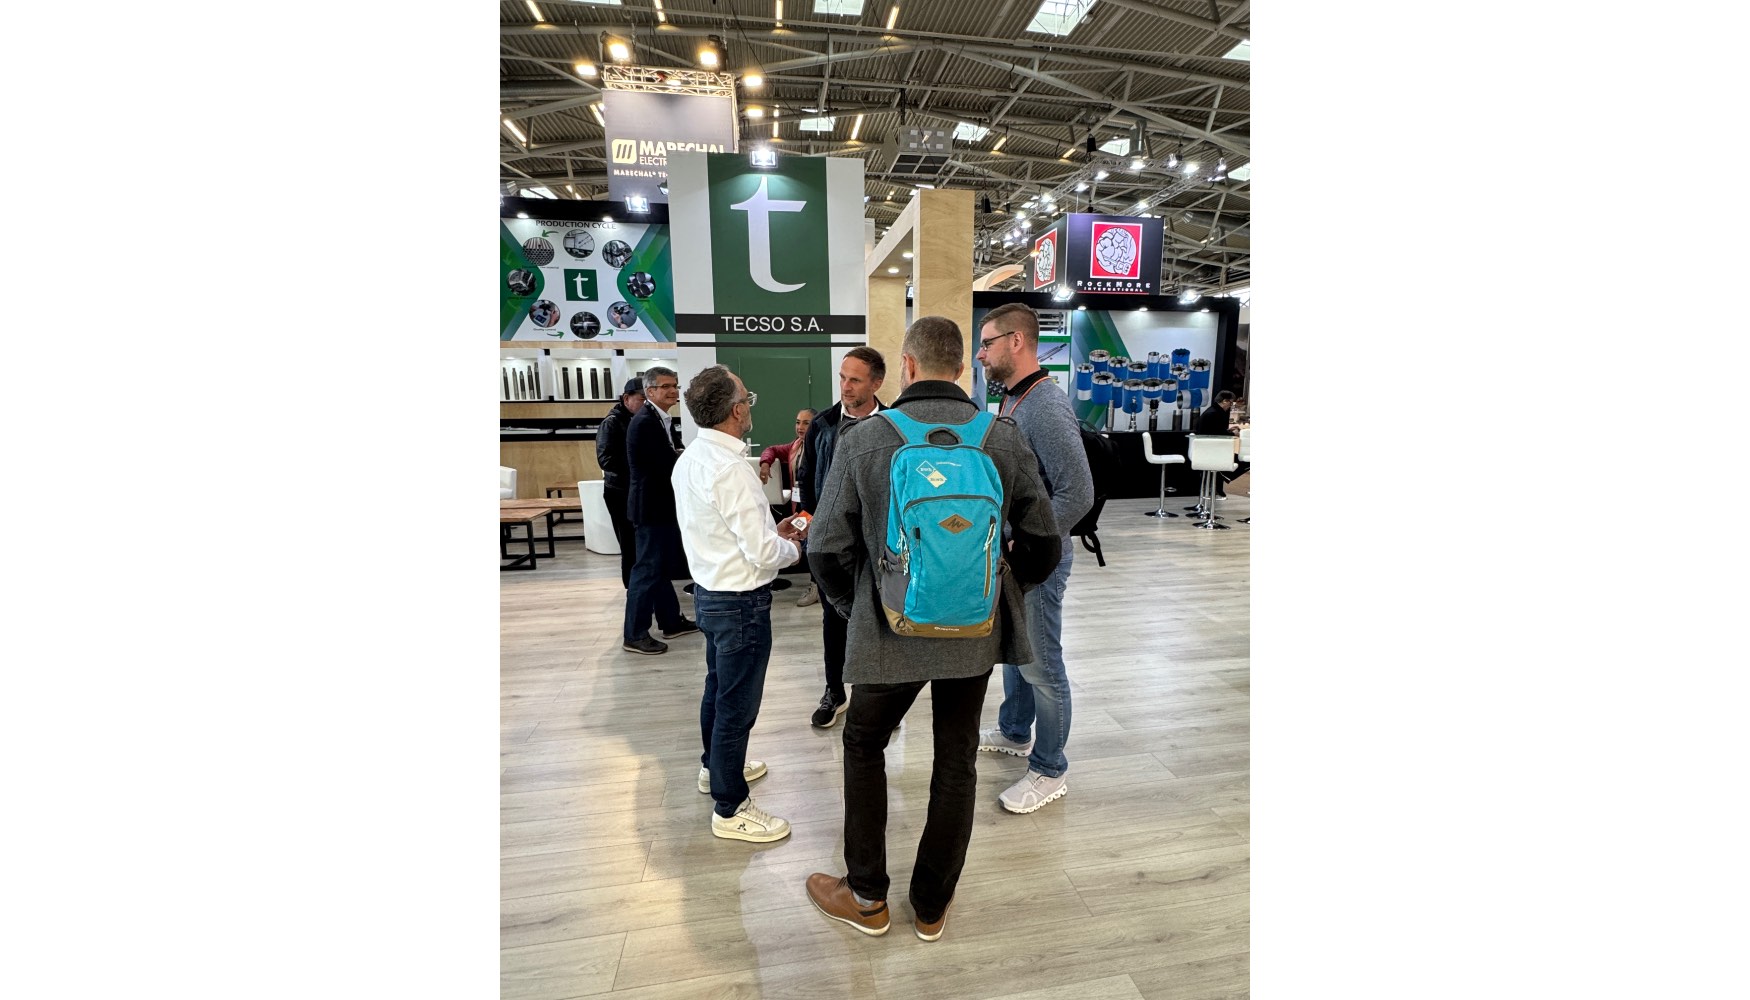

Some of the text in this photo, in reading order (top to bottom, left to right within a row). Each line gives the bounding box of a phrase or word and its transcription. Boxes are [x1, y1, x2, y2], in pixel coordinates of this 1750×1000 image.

[536, 220, 617, 230] PRODUCTION CYCLE
[730, 176, 807, 293] t
[573, 272, 589, 299] t
[721, 316, 824, 332] TECSO S.A.
